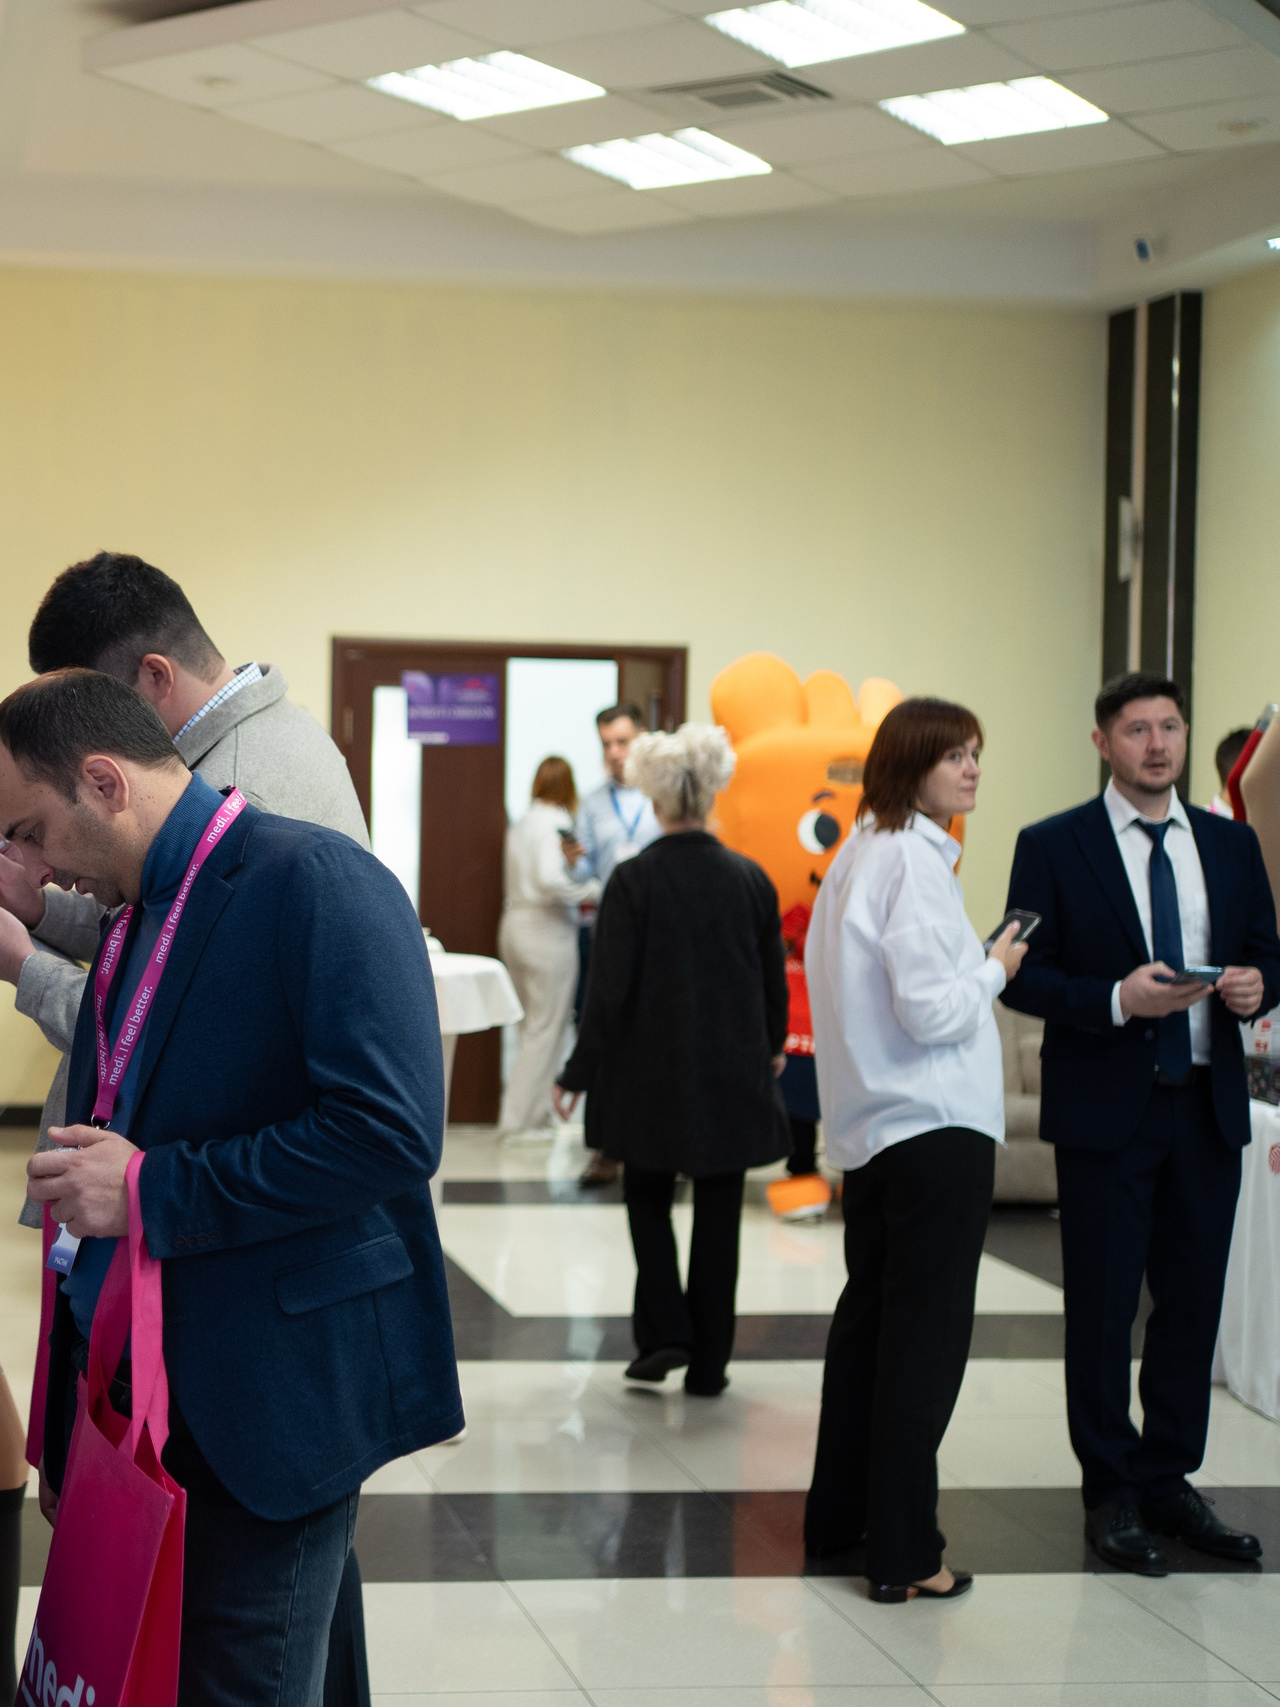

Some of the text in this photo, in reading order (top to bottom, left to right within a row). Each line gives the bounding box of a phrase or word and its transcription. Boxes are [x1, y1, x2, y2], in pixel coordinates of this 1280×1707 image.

[206, 815, 230, 843] medi.
[228, 793, 243, 814] feel
[113, 919, 128, 938] feel
[156, 932, 173, 963] medi.
[169, 902, 182, 924] feel
[179, 863, 199, 899] better.
[100, 940, 120, 975] better.
[98, 1029, 106, 1049] feel
[109, 1054, 127, 1085] medi.
[121, 1023, 138, 1047] feel
[130, 986, 153, 1023] better.
[24, 1618, 96, 1707] me
